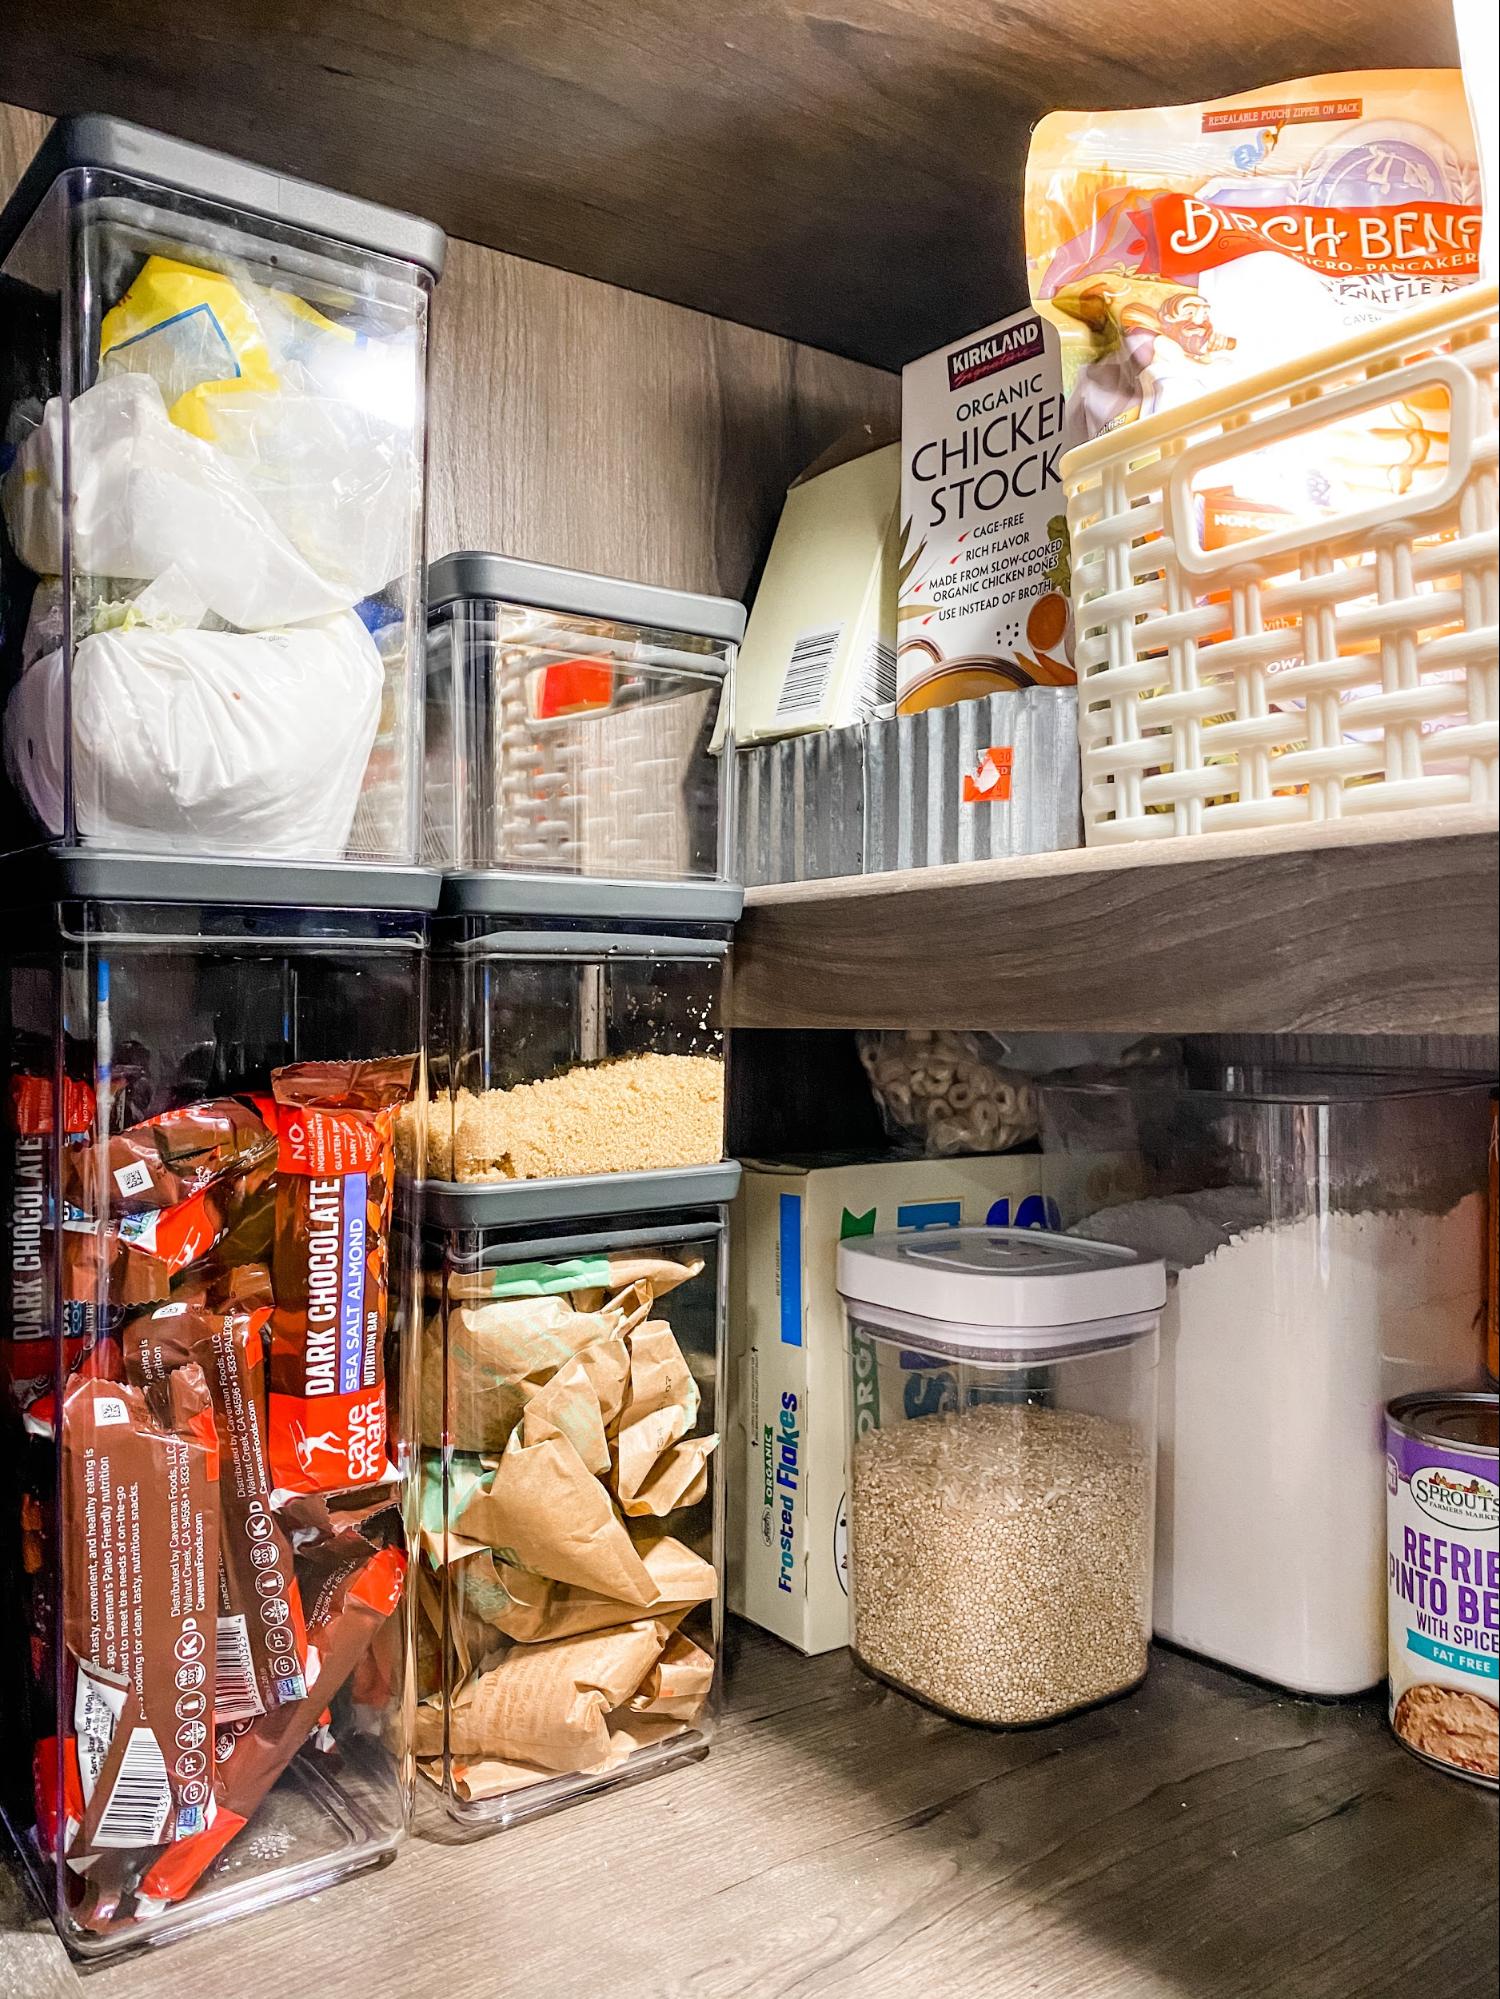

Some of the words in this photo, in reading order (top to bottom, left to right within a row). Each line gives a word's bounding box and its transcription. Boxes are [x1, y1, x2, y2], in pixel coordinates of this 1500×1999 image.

[1208, 112, 1259, 126] RESEALABLE
[1292, 106, 1320, 118] ZIPPER
[1323, 104, 1335, 114] ON
[1170, 199, 1348, 259] BIRCH
[952, 322, 1040, 375] KIRKLAND
[956, 373, 1044, 422] ORGANIC
[929, 442, 1063, 527] STOCK
[972, 512, 1026, 539] CAGE-FREE
[965, 544, 989, 562] RICH
[991, 531, 1031, 554] FLAVOR
[928, 574, 958, 590] MADE
[960, 566, 989, 583] FROM
[991, 538, 1063, 573] SLOW-COOKED
[933, 581, 979, 602] ORGANIC
[981, 569, 1026, 591] CHICKEN
[1027, 554, 1060, 577] BONES
[938, 607, 956, 622] USE
[958, 595, 1000, 618] INSTEAD
[1002, 591, 1016, 605] OF
[1018, 579, 1052, 602] BROTH
[288, 1122, 307, 1161] NO
[306, 1118, 315, 1168] ARTIFICIAL
[315, 1112, 325, 1172] INGREDIENTS
[333, 1135, 343, 1170] GLUTEN
[350, 1138, 358, 1165] DAIRY
[12, 1136, 43, 1271] CHOCOLATE
[307, 1178, 341, 1322] CHOCOLATE
[347, 1218, 364, 1300] ALMOND
[12, 1278, 43, 1341] DARK
[85, 1302, 95, 1333] NUTRI
[367, 1311, 378, 1332] BAR
[138, 1338, 149, 1348] is
[346, 1305, 361, 1350] SALT
[140, 1349, 153, 1380] eating
[153, 1346, 165, 1378] trition
[216, 1355, 228, 1386] Foods,
[304, 1327, 337, 1396] DARK
[345, 1352, 359, 1391] SEA
[363, 1333, 378, 1386] NUTRITION
[222, 1387, 236, 1432] Caveman
[232, 1387, 244, 1415] 94596
[229, 1434, 239, 1446] by
[236, 1416, 246, 1431] CA
[366, 1400, 381, 1477] man
[83, 1448, 94, 1458] is
[239, 1432, 251, 1462] Creek,
[246, 1400, 269, 1495] CavemanFoods.com
[347, 1403, 367, 1480] cave
[776, 1391, 800, 1491] Flakes
[84, 1459, 96, 1494] eating
[99, 1455, 111, 1503] nutrition
[167, 1466, 179, 1499] Foods,
[229, 1447, 246, 1498] Distributed
[245, 1463, 257, 1497] Walnut
[764, 1433, 774, 1499] ORGANIC
[85, 1496, 98, 1537] healthy
[115, 1485, 127, 1539] on-the-go
[128, 1482, 140, 1521] snacks.
[180, 1499, 191, 1529] 94596
[249, 1500, 263, 1514] D
[1429, 1501, 1464, 1515] FARMERS
[1465, 1510, 1500, 1521] MARKE
[100, 1505, 113, 1549] Friendly
[168, 1500, 179, 1548] Caveman
[180, 1529, 191, 1546] CA
[86, 1538, 97, 1559] and
[115, 1541, 127, 1553] of
[130, 1522, 142, 1574] nutritious
[170, 1550, 181, 1562] by
[253, 1549, 263, 1565] NO
[261, 1548, 271, 1564] SOY
[778, 1494, 794, 1593] Frosted
[1404, 1525, 1500, 1590] REFRIE
[102, 1550, 113, 1581] Paleo
[116, 1555, 128, 1588] needs
[181, 1547, 192, 1578] Creek,
[194, 1512, 206, 1612] CavemanFoods.com
[87, 1560, 99, 1622] convenient,
[118, 1589, 128, 1607] the
[131, 1575, 143, 1604] tasty,
[169, 1562, 181, 1618] Distributed
[182, 1579, 193, 1615] Walnut
[217, 1568, 231, 1611] snackers
[1389, 1552, 1448, 1617] PINTO
[1458, 1584, 1500, 1630] BE
[102, 1582, 115, 1640] Caveman's
[118, 1609, 129, 1637] meet
[132, 1605, 143, 1637] clean,
[181, 1617, 197, 1632] D
[89, 1624, 101, 1653] tasty,
[119, 1639, 129, 1651] to
[133, 1639, 143, 1655] for
[181, 1635, 198, 1658] K
[274, 1632, 286, 1648] PF
[1416, 1609, 1449, 1641] WITH
[1453, 1624, 1500, 1654] SPICE
[106, 1641, 117, 1665] ago.
[238, 1635, 251, 1666] 00325
[280, 1658, 290, 1672] GF
[1433, 1646, 1454, 1664] FAT
[1459, 1654, 1491, 1673] FREE
[134, 1656, 145, 1695] looking
[178, 1670, 188, 1687] NO
[187, 1668, 196, 1685] SOY
[186, 1757, 197, 1773] PF
[189, 1785, 199, 1799] GF
